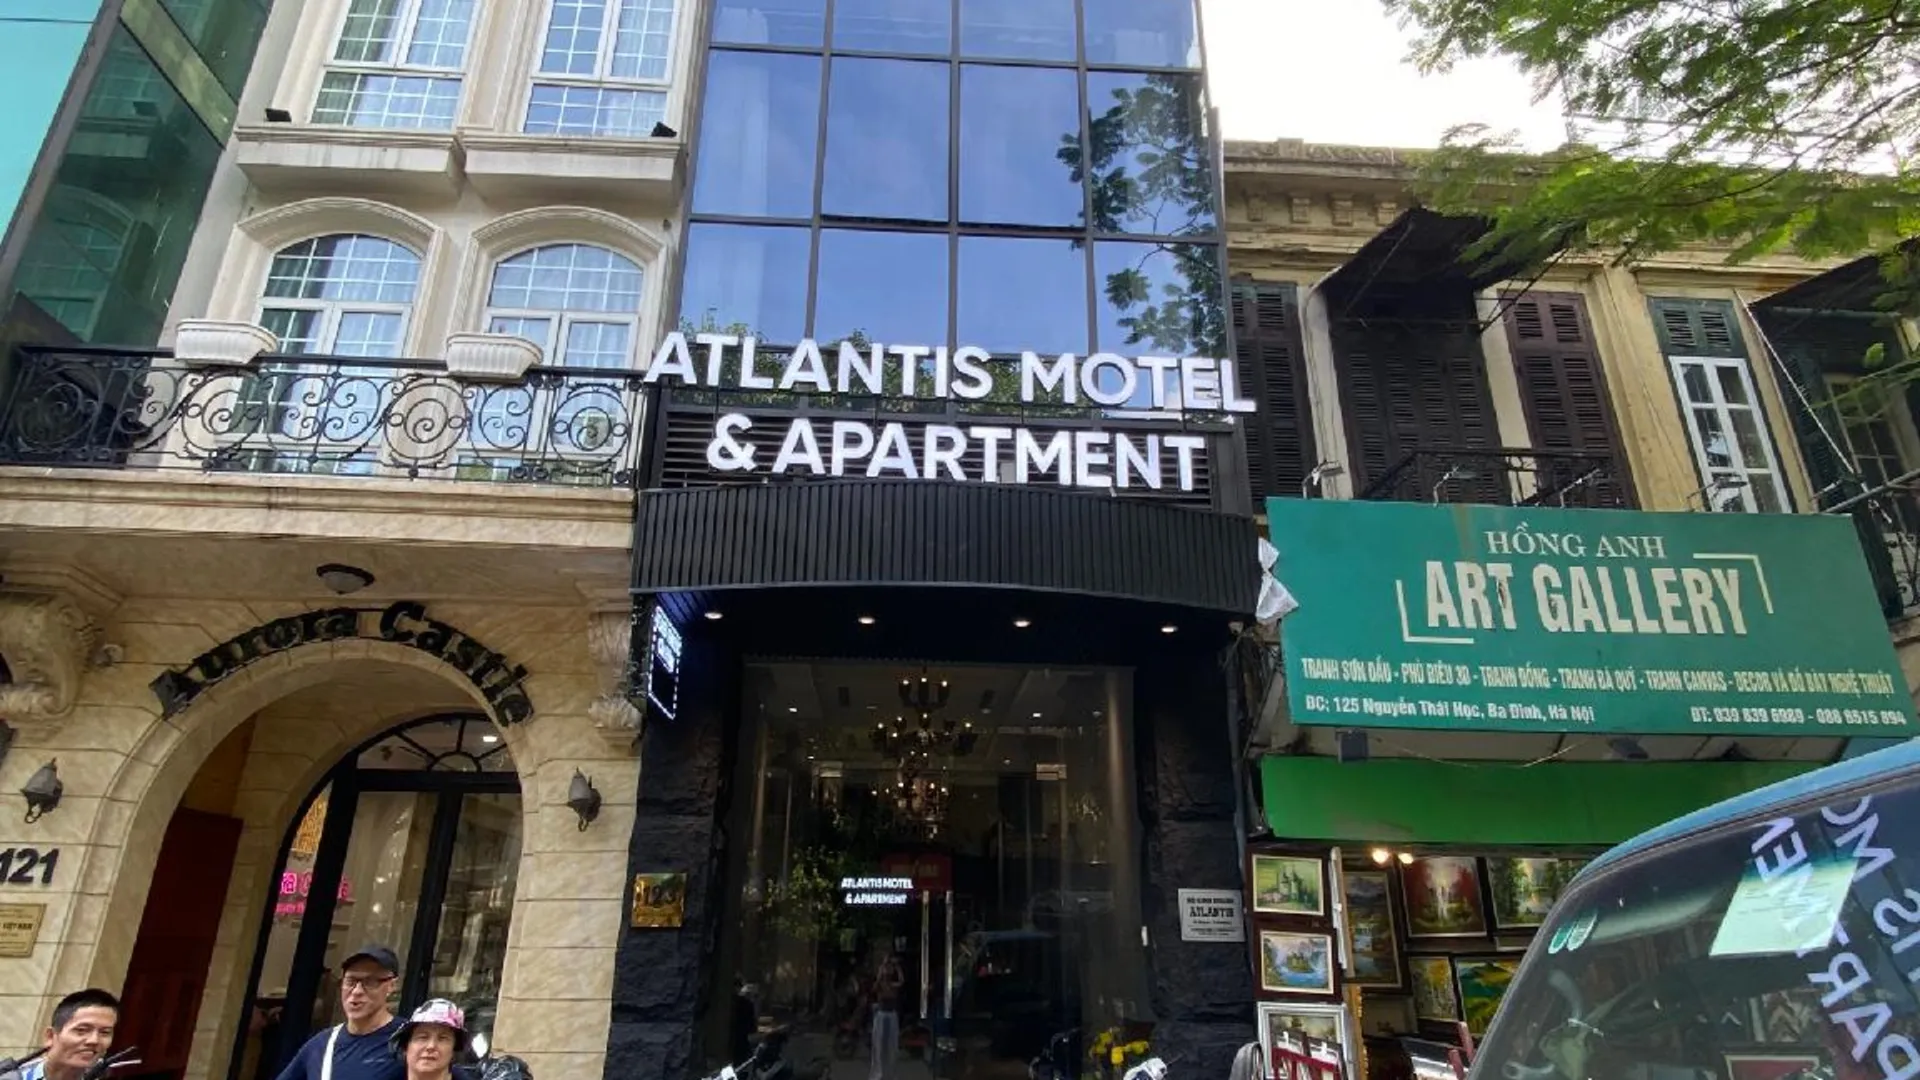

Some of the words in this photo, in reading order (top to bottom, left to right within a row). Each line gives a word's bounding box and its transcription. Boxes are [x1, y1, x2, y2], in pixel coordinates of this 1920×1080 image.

[643, 331, 993, 399] ATLANTIS
[1021, 350, 1257, 412] MOTEL
[706, 413, 758, 472] &
[772, 417, 1205, 491] APARTMENT
[1484, 521, 1587, 557] HỒNG
[1596, 536, 1667, 559] ANH
[1426, 560, 1517, 631] ART
[1532, 563, 1748, 635] GALLERY
[149, 607, 358, 718] Aurora
[380, 601, 534, 726] Castle
[1301, 657, 1339, 681] TRANH
[1455, 665, 1472, 686] 3D
[1479, 666, 1517, 688] TRANH
[1558, 668, 1597, 690] TRANH
[1645, 670, 1683, 691] TRANH
[1683, 670, 1727, 692] CANVAS
[1733, 671, 1772, 692] DECOR
[1334, 697, 1359, 714] 125
[1419, 700, 1449, 716] Thái
[1488, 703, 1507, 719] Ba
[1548, 704, 1568, 720] Hà
[1571, 705, 1595, 724] Nội
[0, 848, 59, 884] 121
[841, 877, 882, 889] ATLANTIS
[883, 877, 914, 889] MOTEL
[853, 892, 907, 904] APARTMENT
